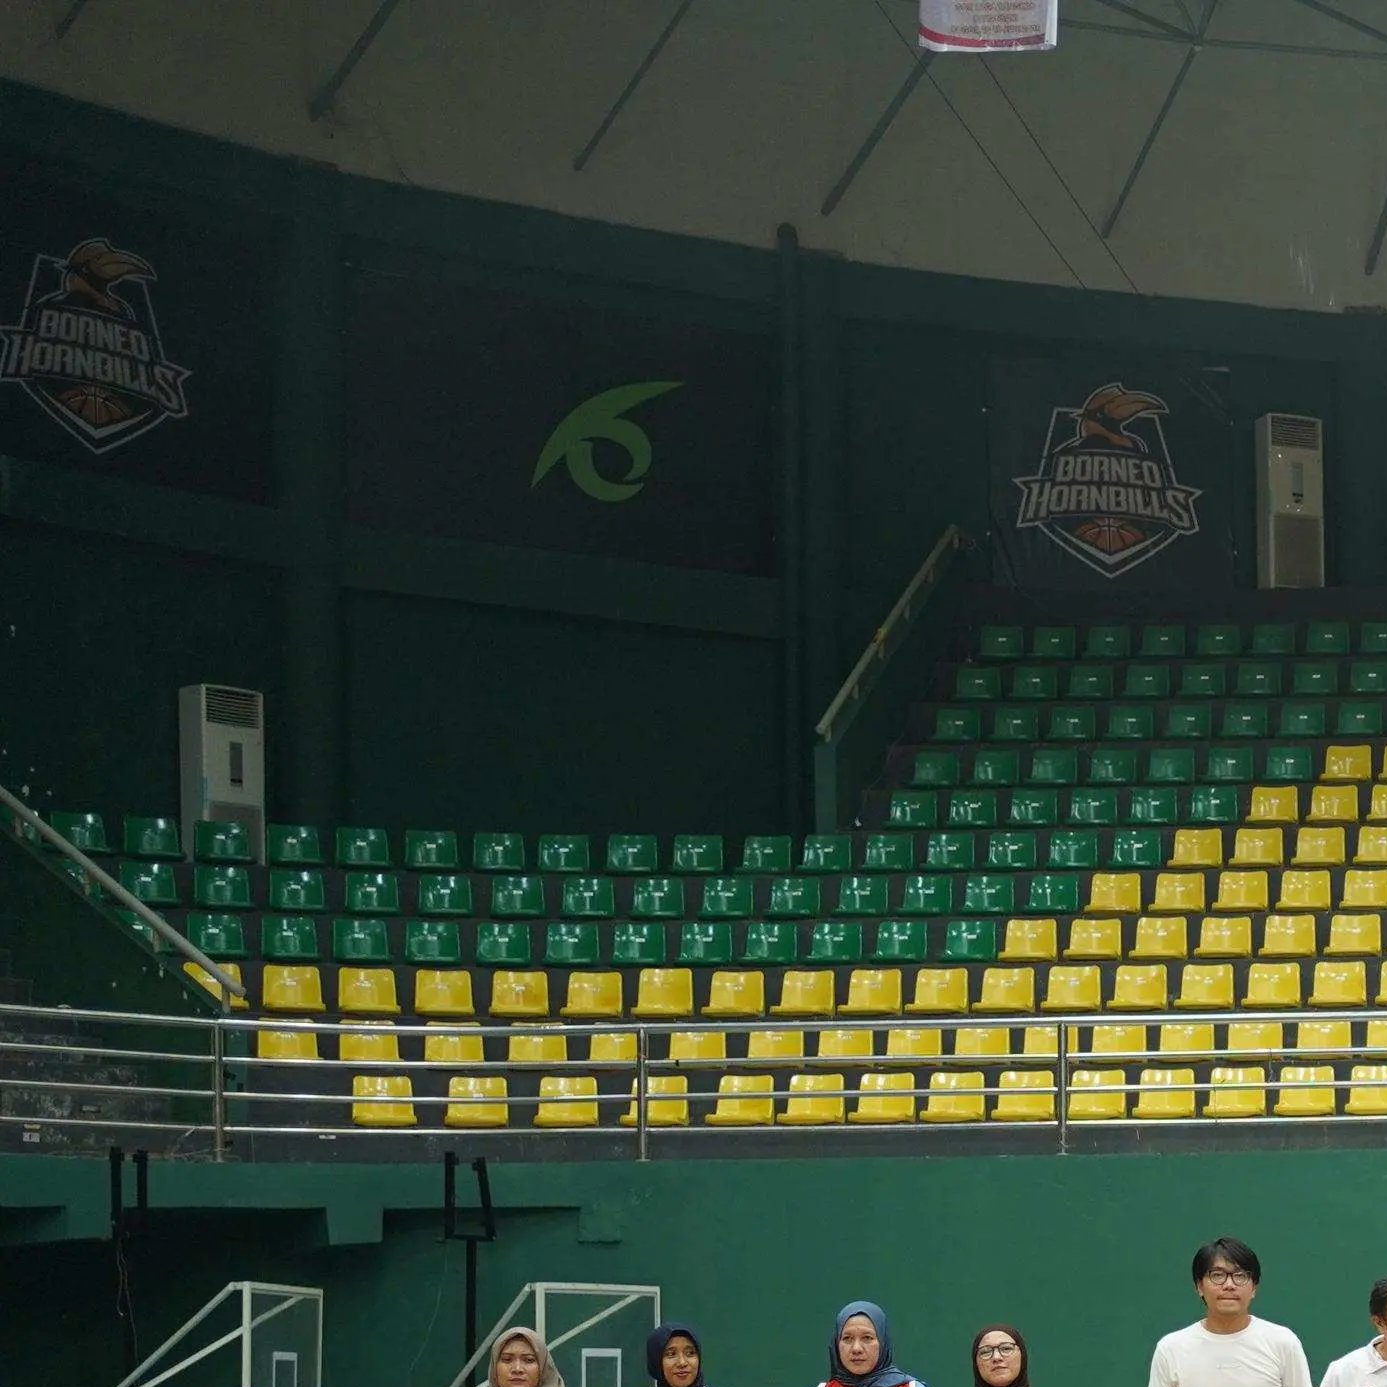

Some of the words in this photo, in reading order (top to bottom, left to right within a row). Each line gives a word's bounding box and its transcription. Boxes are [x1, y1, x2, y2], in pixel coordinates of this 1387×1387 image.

[38, 308, 149, 360] BORNEO
[4, 332, 184, 406] HORNBILLS
[1057, 456, 1162, 487] BORNEO
[1025, 480, 1192, 526] HORNBILLS
